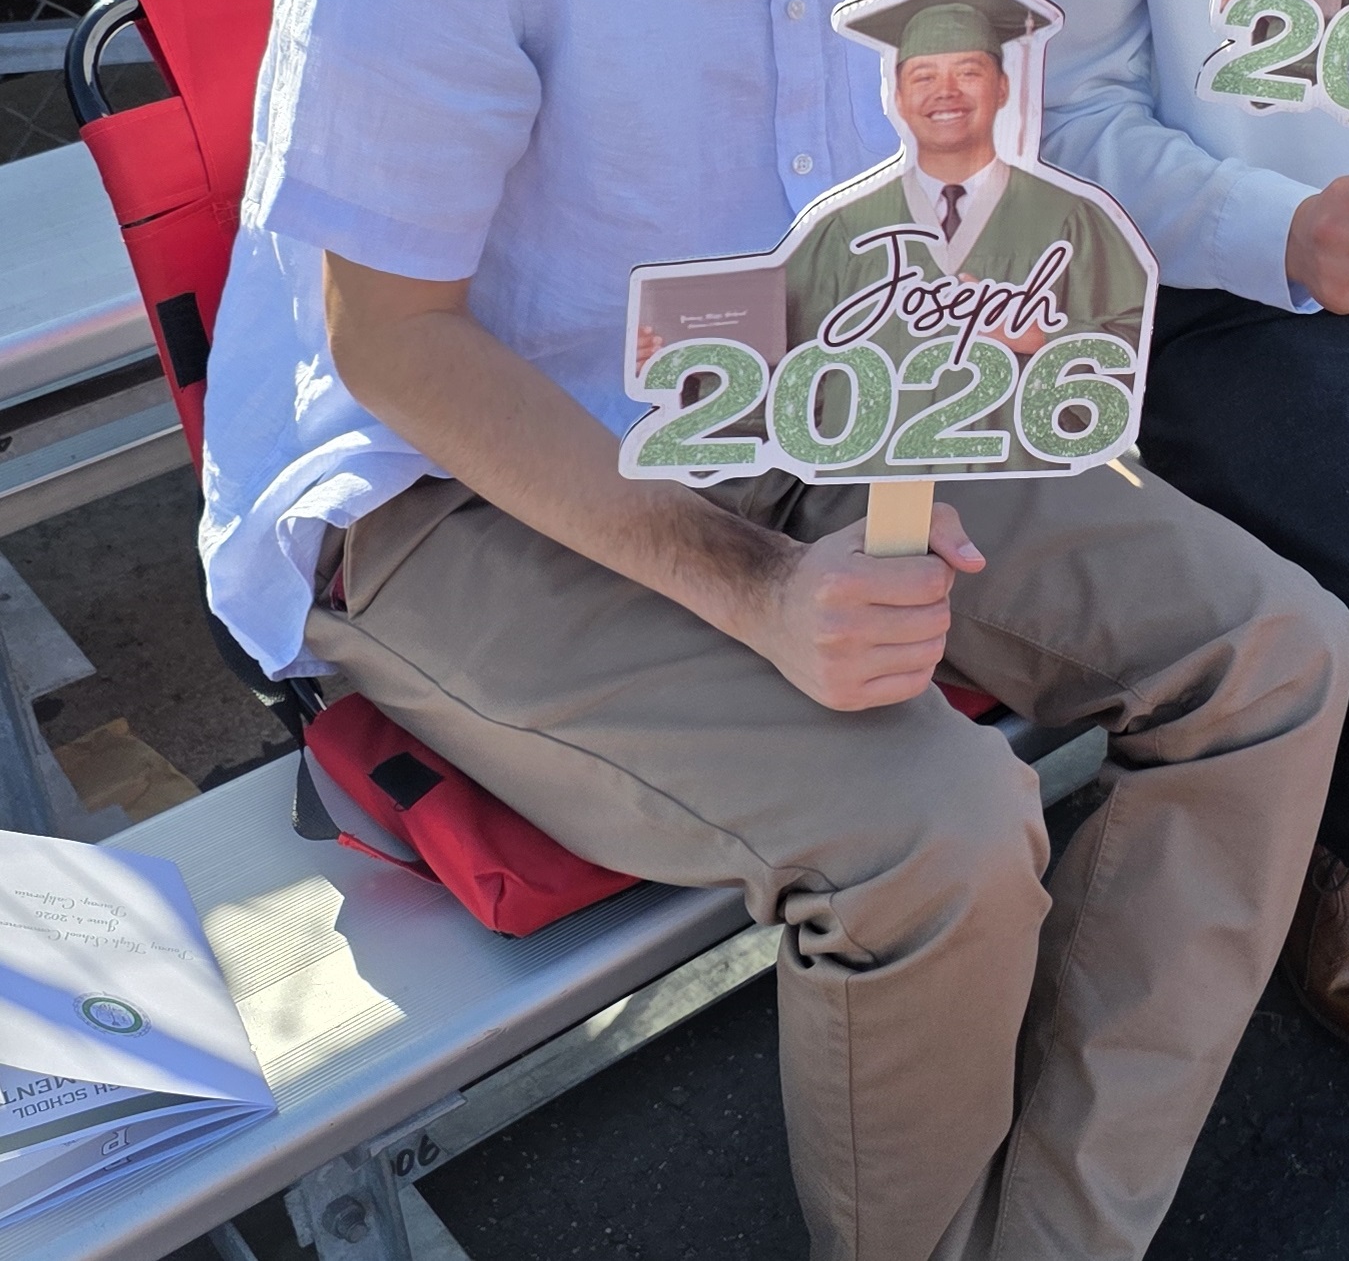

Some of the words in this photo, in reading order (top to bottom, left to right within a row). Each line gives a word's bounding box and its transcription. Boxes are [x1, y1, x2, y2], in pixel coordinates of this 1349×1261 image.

[822, 228, 1064, 366] Joseph
[636, 336, 1136, 468] 2026
[13, 889, 75, 910] California
[34, 910, 68, 922] 2026
[86, 918, 120, 933] June
[64, 931, 108, 948] School
[111, 936, 146, 955] High
[150, 941, 194, 962] Poway
[12, 1087, 88, 1119] SCHOOL
[390, 1134, 441, 1177] 06
